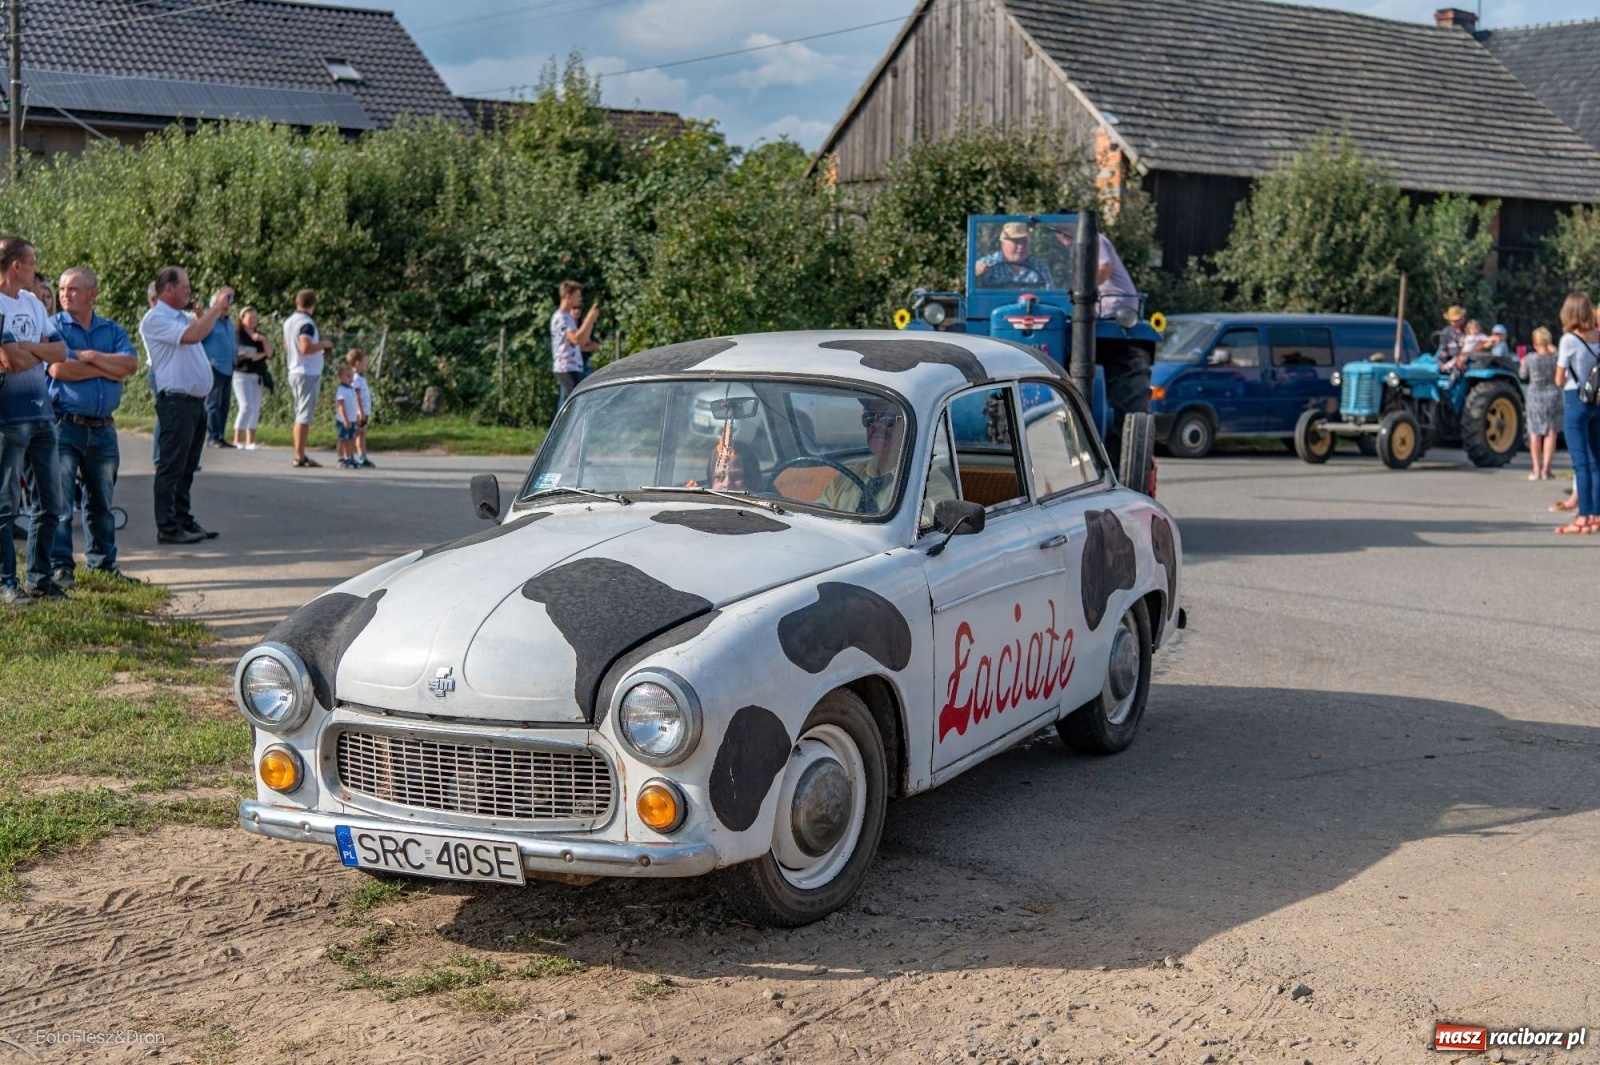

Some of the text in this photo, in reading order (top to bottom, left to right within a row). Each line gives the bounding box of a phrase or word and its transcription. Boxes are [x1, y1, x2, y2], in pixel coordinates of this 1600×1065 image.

[343, 850, 356, 860] PL
[357, 833, 517, 880] SRC 40SE
